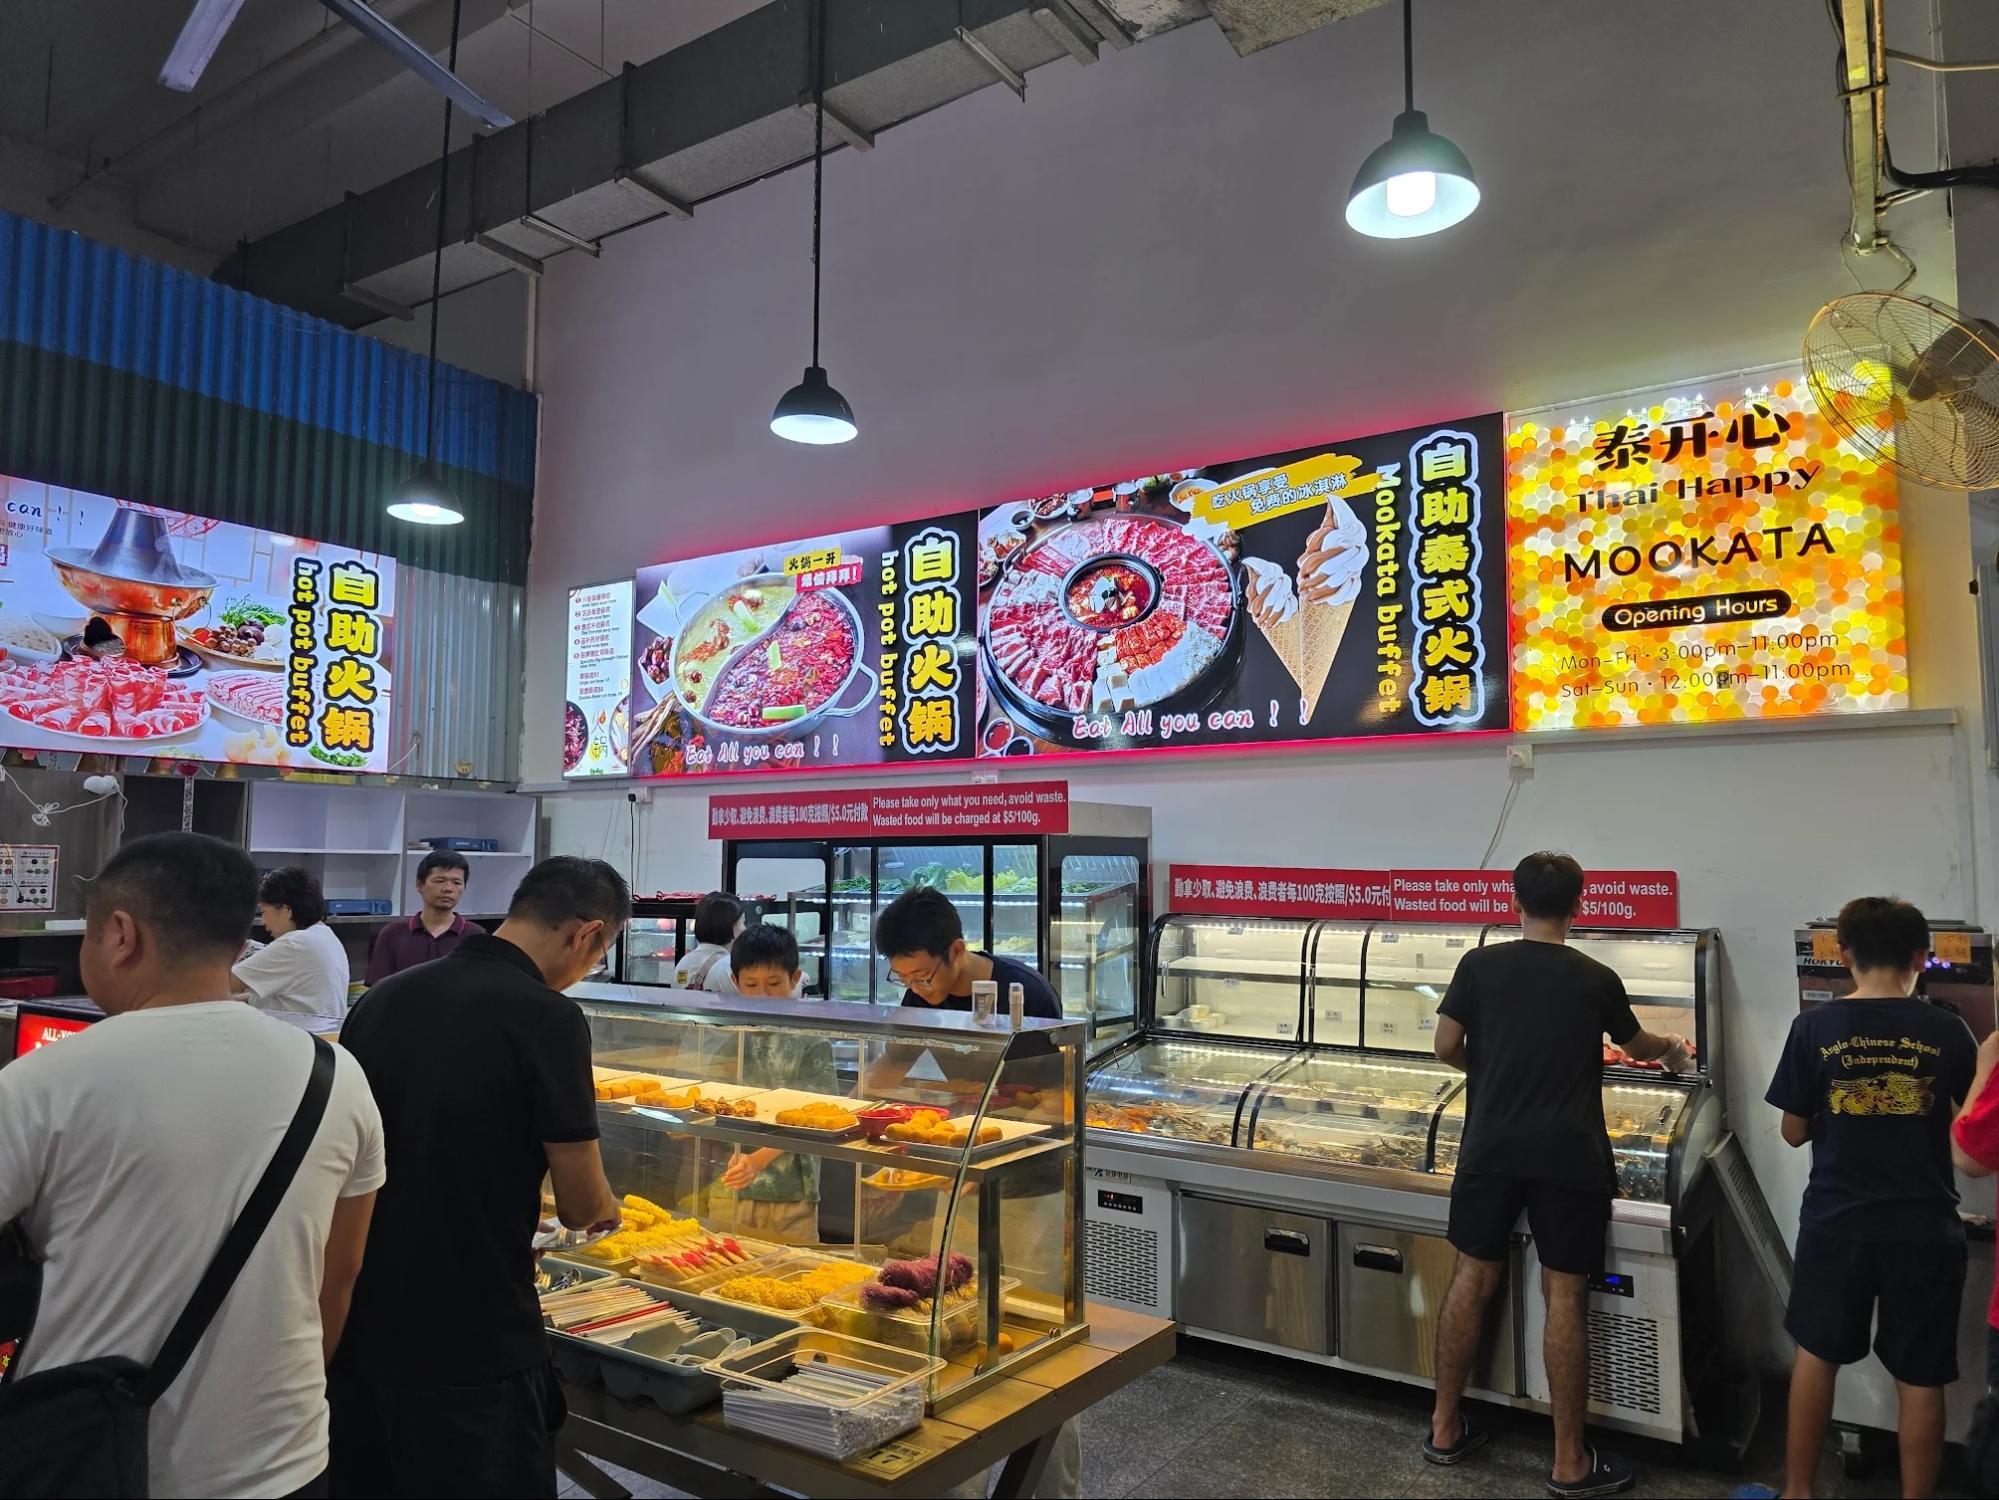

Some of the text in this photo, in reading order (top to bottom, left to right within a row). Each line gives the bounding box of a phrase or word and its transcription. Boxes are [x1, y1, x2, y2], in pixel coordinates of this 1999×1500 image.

[1594, 403, 1791, 471] 泰开心
[1211, 473, 1289, 509] 吃火锅享受
[1250, 473, 1348, 515] 免费的冰淇淋
[1572, 465, 1821, 512] Thai Happy
[1564, 523, 1836, 582] MOOKATA
[1375, 462, 1403, 713] Mookata buffet
[1420, 442, 1473, 714] 自助泰式火锅
[1614, 597, 1778, 627] Opening Hours
[289, 560, 320, 745] hot pot buffet
[321, 563, 376, 749] 自助火锅
[878, 550, 899, 747] hot pot buffet
[906, 536, 954, 745] 自助火锅
[1072, 715, 1112, 739] Eat
[1121, 709, 1153, 737] All
[1160, 712, 1200, 739] you
[1207, 709, 1254, 730] can
[685, 745, 713, 765] Eat
[717, 741, 740, 762] All
[744, 744, 770, 765] you
[774, 741, 804, 759] can
[873, 791, 1066, 810] Please take only what you need, avoid waste.
[873, 810, 1040, 827] Wasted food will be charged at $5/100g.
[1394, 878, 1431, 893] Please
[1435, 878, 1460, 893] take
[1463, 879, 1488, 896] only
[1491, 879, 1516, 893] wha
[1589, 882, 1625, 896] avoid
[1630, 882, 1673, 896] waste.
[1394, 897, 1637, 919] Wasted food will be $5/100g.
[1820, 1036, 1941, 1061] Anglo-Chinese School
[1841, 1055, 1919, 1070] (Independent)
